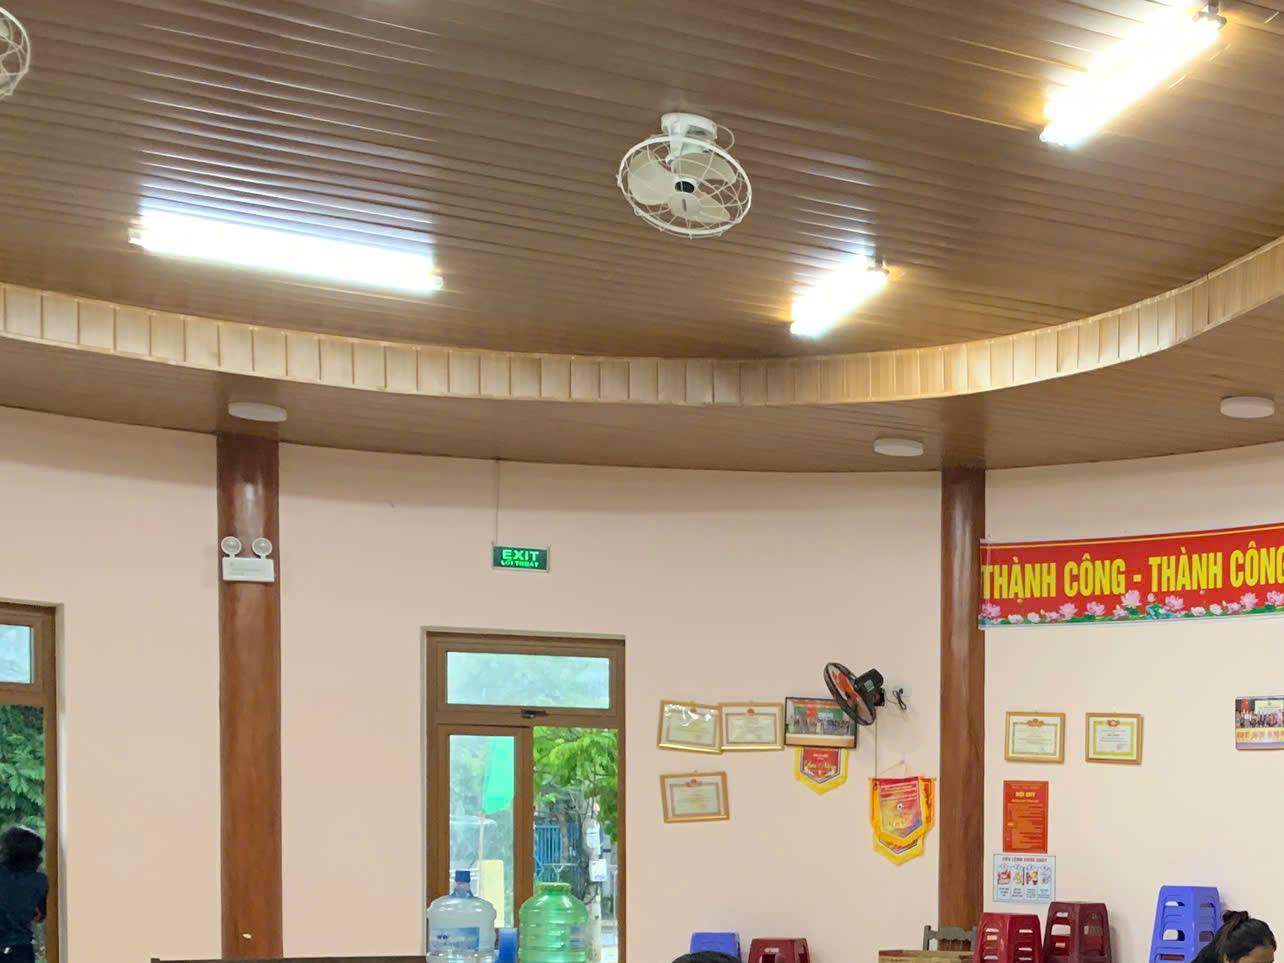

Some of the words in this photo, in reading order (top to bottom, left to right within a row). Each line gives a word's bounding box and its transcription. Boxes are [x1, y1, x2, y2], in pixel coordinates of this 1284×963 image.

[502, 549, 539, 561] EXIT
[981, 557, 1056, 599] THÀNH
[1064, 552, 1126, 597] CÔNG
[1149, 547, 1223, 592] THÀNH
